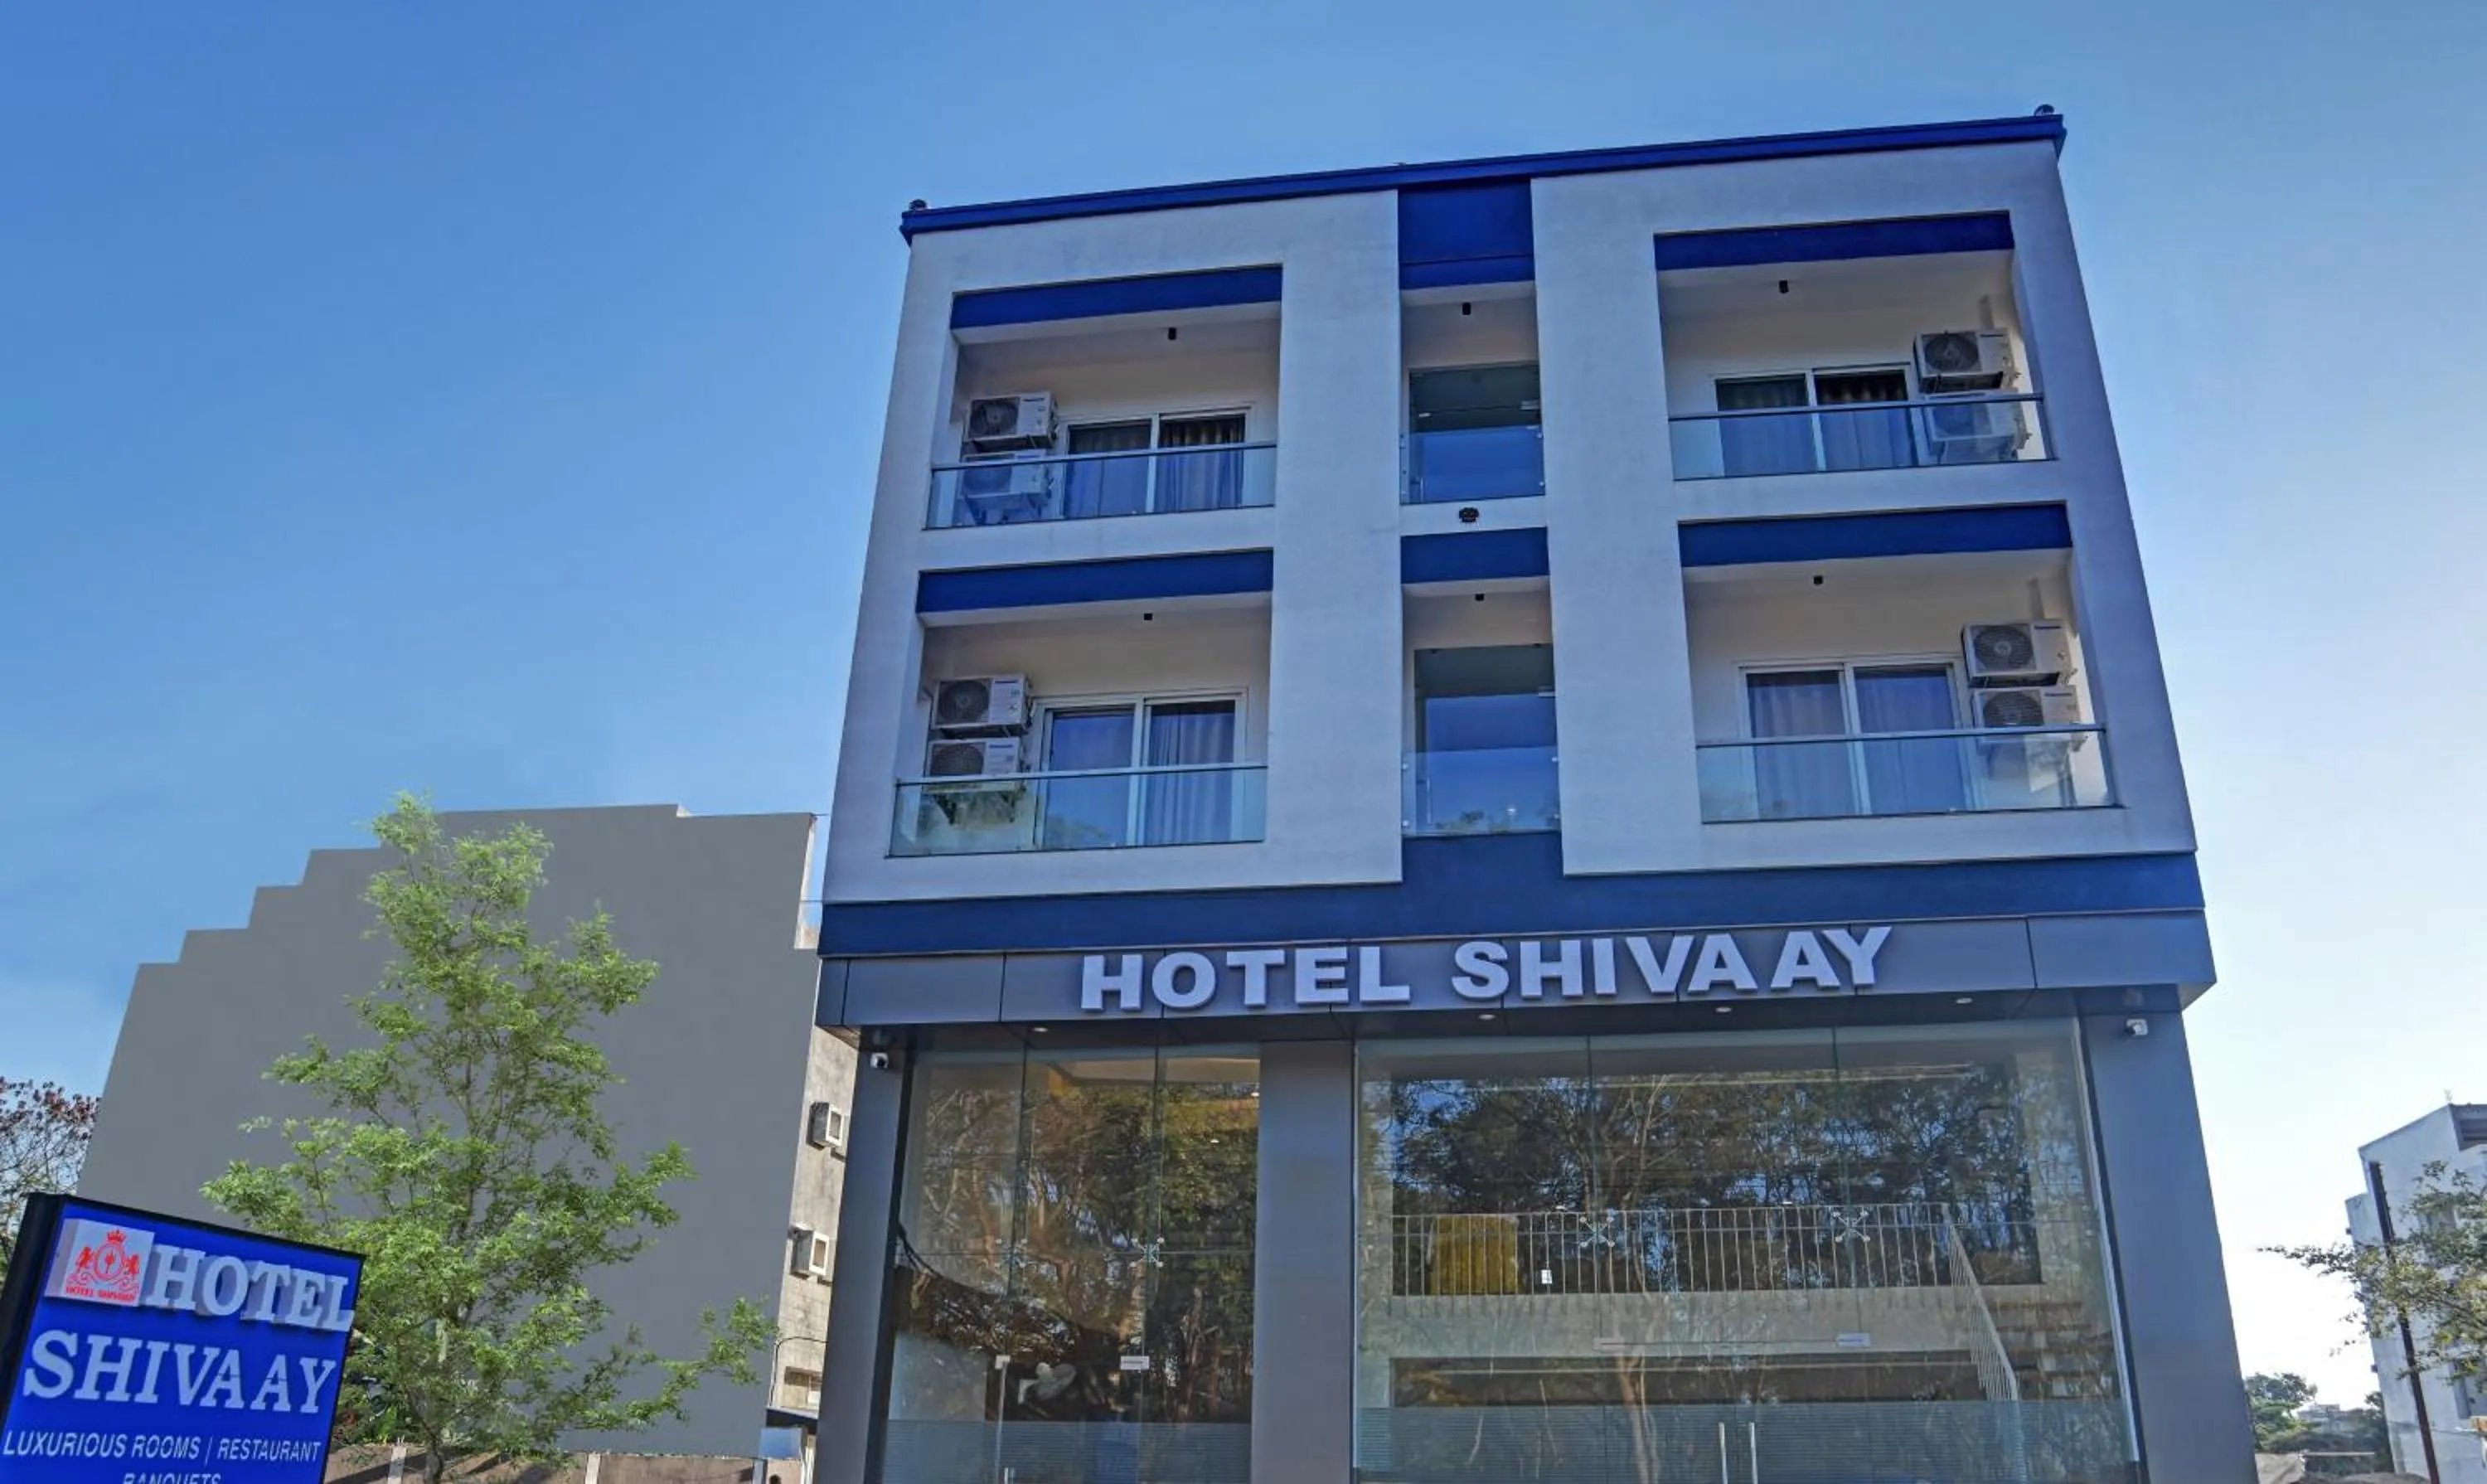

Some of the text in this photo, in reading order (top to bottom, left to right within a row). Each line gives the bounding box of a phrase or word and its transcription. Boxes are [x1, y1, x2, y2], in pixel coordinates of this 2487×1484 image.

[1080, 926, 1892, 1011] HOTEL SHIVAAY
[147, 1244, 355, 1331] HOTEL
[23, 1329, 336, 1414] SHIVAAY
[2, 1430, 128, 1458] LUXURIOUS
[131, 1434, 201, 1460] ROOMS
[218, 1438, 322, 1462] RESTAURANT
